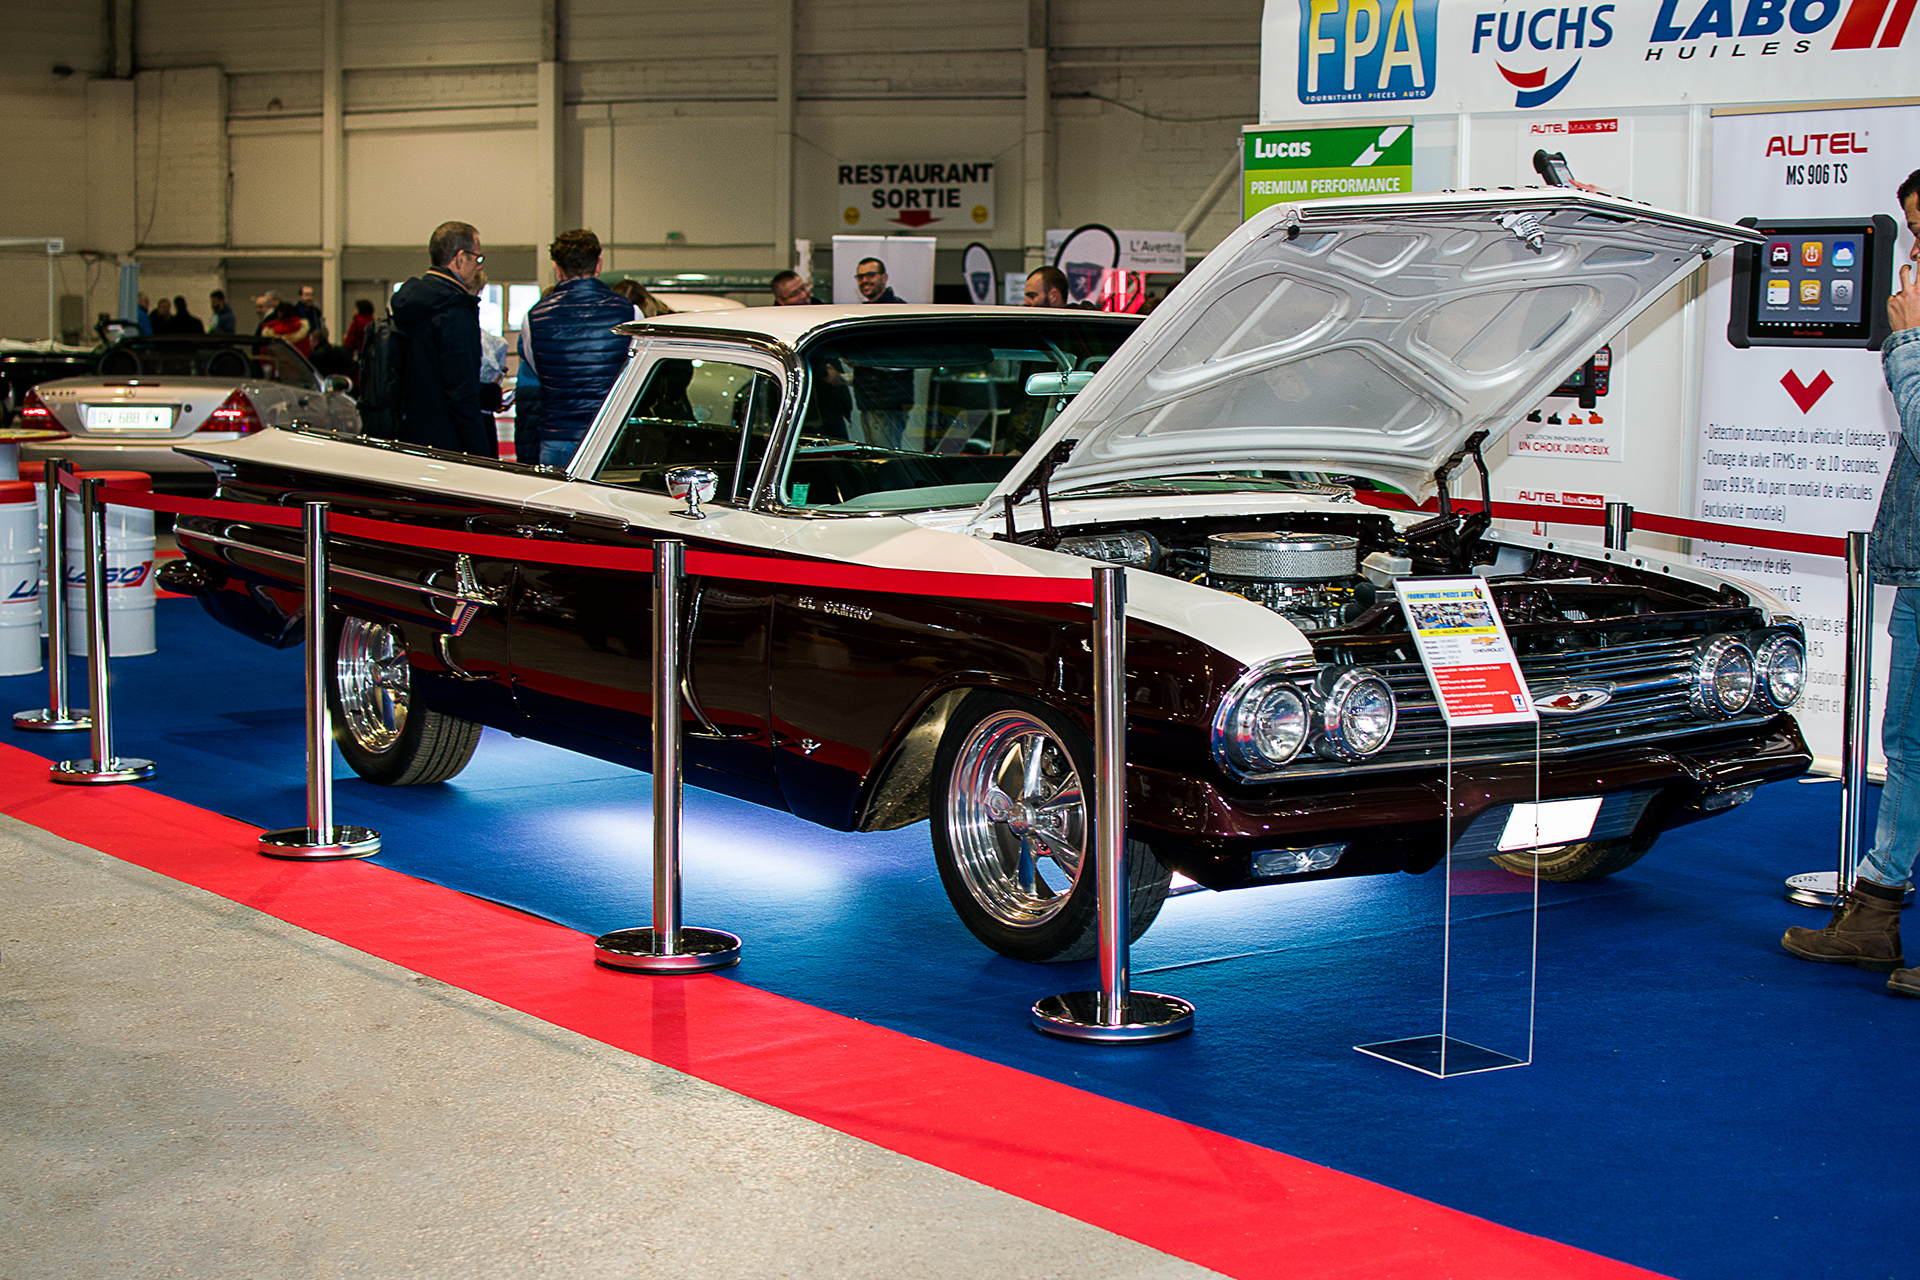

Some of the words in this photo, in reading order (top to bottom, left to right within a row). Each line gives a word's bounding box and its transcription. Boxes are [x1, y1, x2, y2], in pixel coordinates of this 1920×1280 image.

[1472, 4, 1616, 54] FUCHS
[1649, 0, 1841, 43] LABO
[1307, 0, 1426, 93] FPA
[1645, 40, 1811, 61] HUILES
[1306, 92, 1362, 102] FOURNITURES
[1368, 91, 1397, 99] PIECES
[1402, 90, 1427, 98] AUTO
[1531, 123, 1567, 135] AUTEL
[1255, 138, 1312, 159] Lucas
[1765, 132, 1868, 158] AUTEL
[838, 163, 994, 185] RESTAURANT
[1786, 164, 1805, 186] MS
[1807, 163, 1830, 185] 906
[1833, 162, 1849, 184] TS
[1251, 180, 1309, 195] PREMIUM
[1311, 177, 1401, 194] PERFORMANCE
[872, 188, 962, 209] SORTIE
[1708, 423, 1744, 440] Détection
[1746, 426, 1796, 446] automatique
[1798, 428, 1808, 444] du
[1810, 428, 1844, 444] véhicule
[1846, 428, 1887, 450] (décodage
[1519, 441, 1531, 451] UN
[1533, 442, 1562, 453] CHOIX
[1564, 444, 1610, 456] JUDICIEUX
[1707, 449, 1736, 470] Clonage
[1738, 451, 1748, 467] de
[1750, 452, 1770, 468] valve
[1772, 452, 1796, 469] TPMS
[1797, 457, 1807, 470] en
[1816, 455, 1826, 471] de
[1828, 455, 1840, 472] 10
[1518, 490, 1561, 503] AUTEL
[1703, 478, 1727, 492] couvre
[1729, 476, 1755, 494] 99.9%
[1757, 478, 1768, 494] du
[1769, 482, 1787, 498] parc
[1788, 481, 1821, 497] mondial
[1823, 482, 1833, 498] de
[1835, 483, 1873, 500] véhicules
[1701, 500, 1744, 519] (exclusivité
[1745, 505, 1787, 523] mondiale)
[1764, 557, 1774, 573] de
[1776, 558, 1792, 575] clés
[798, 596, 816, 611] EL
[823, 600, 874, 621] CAMINO
